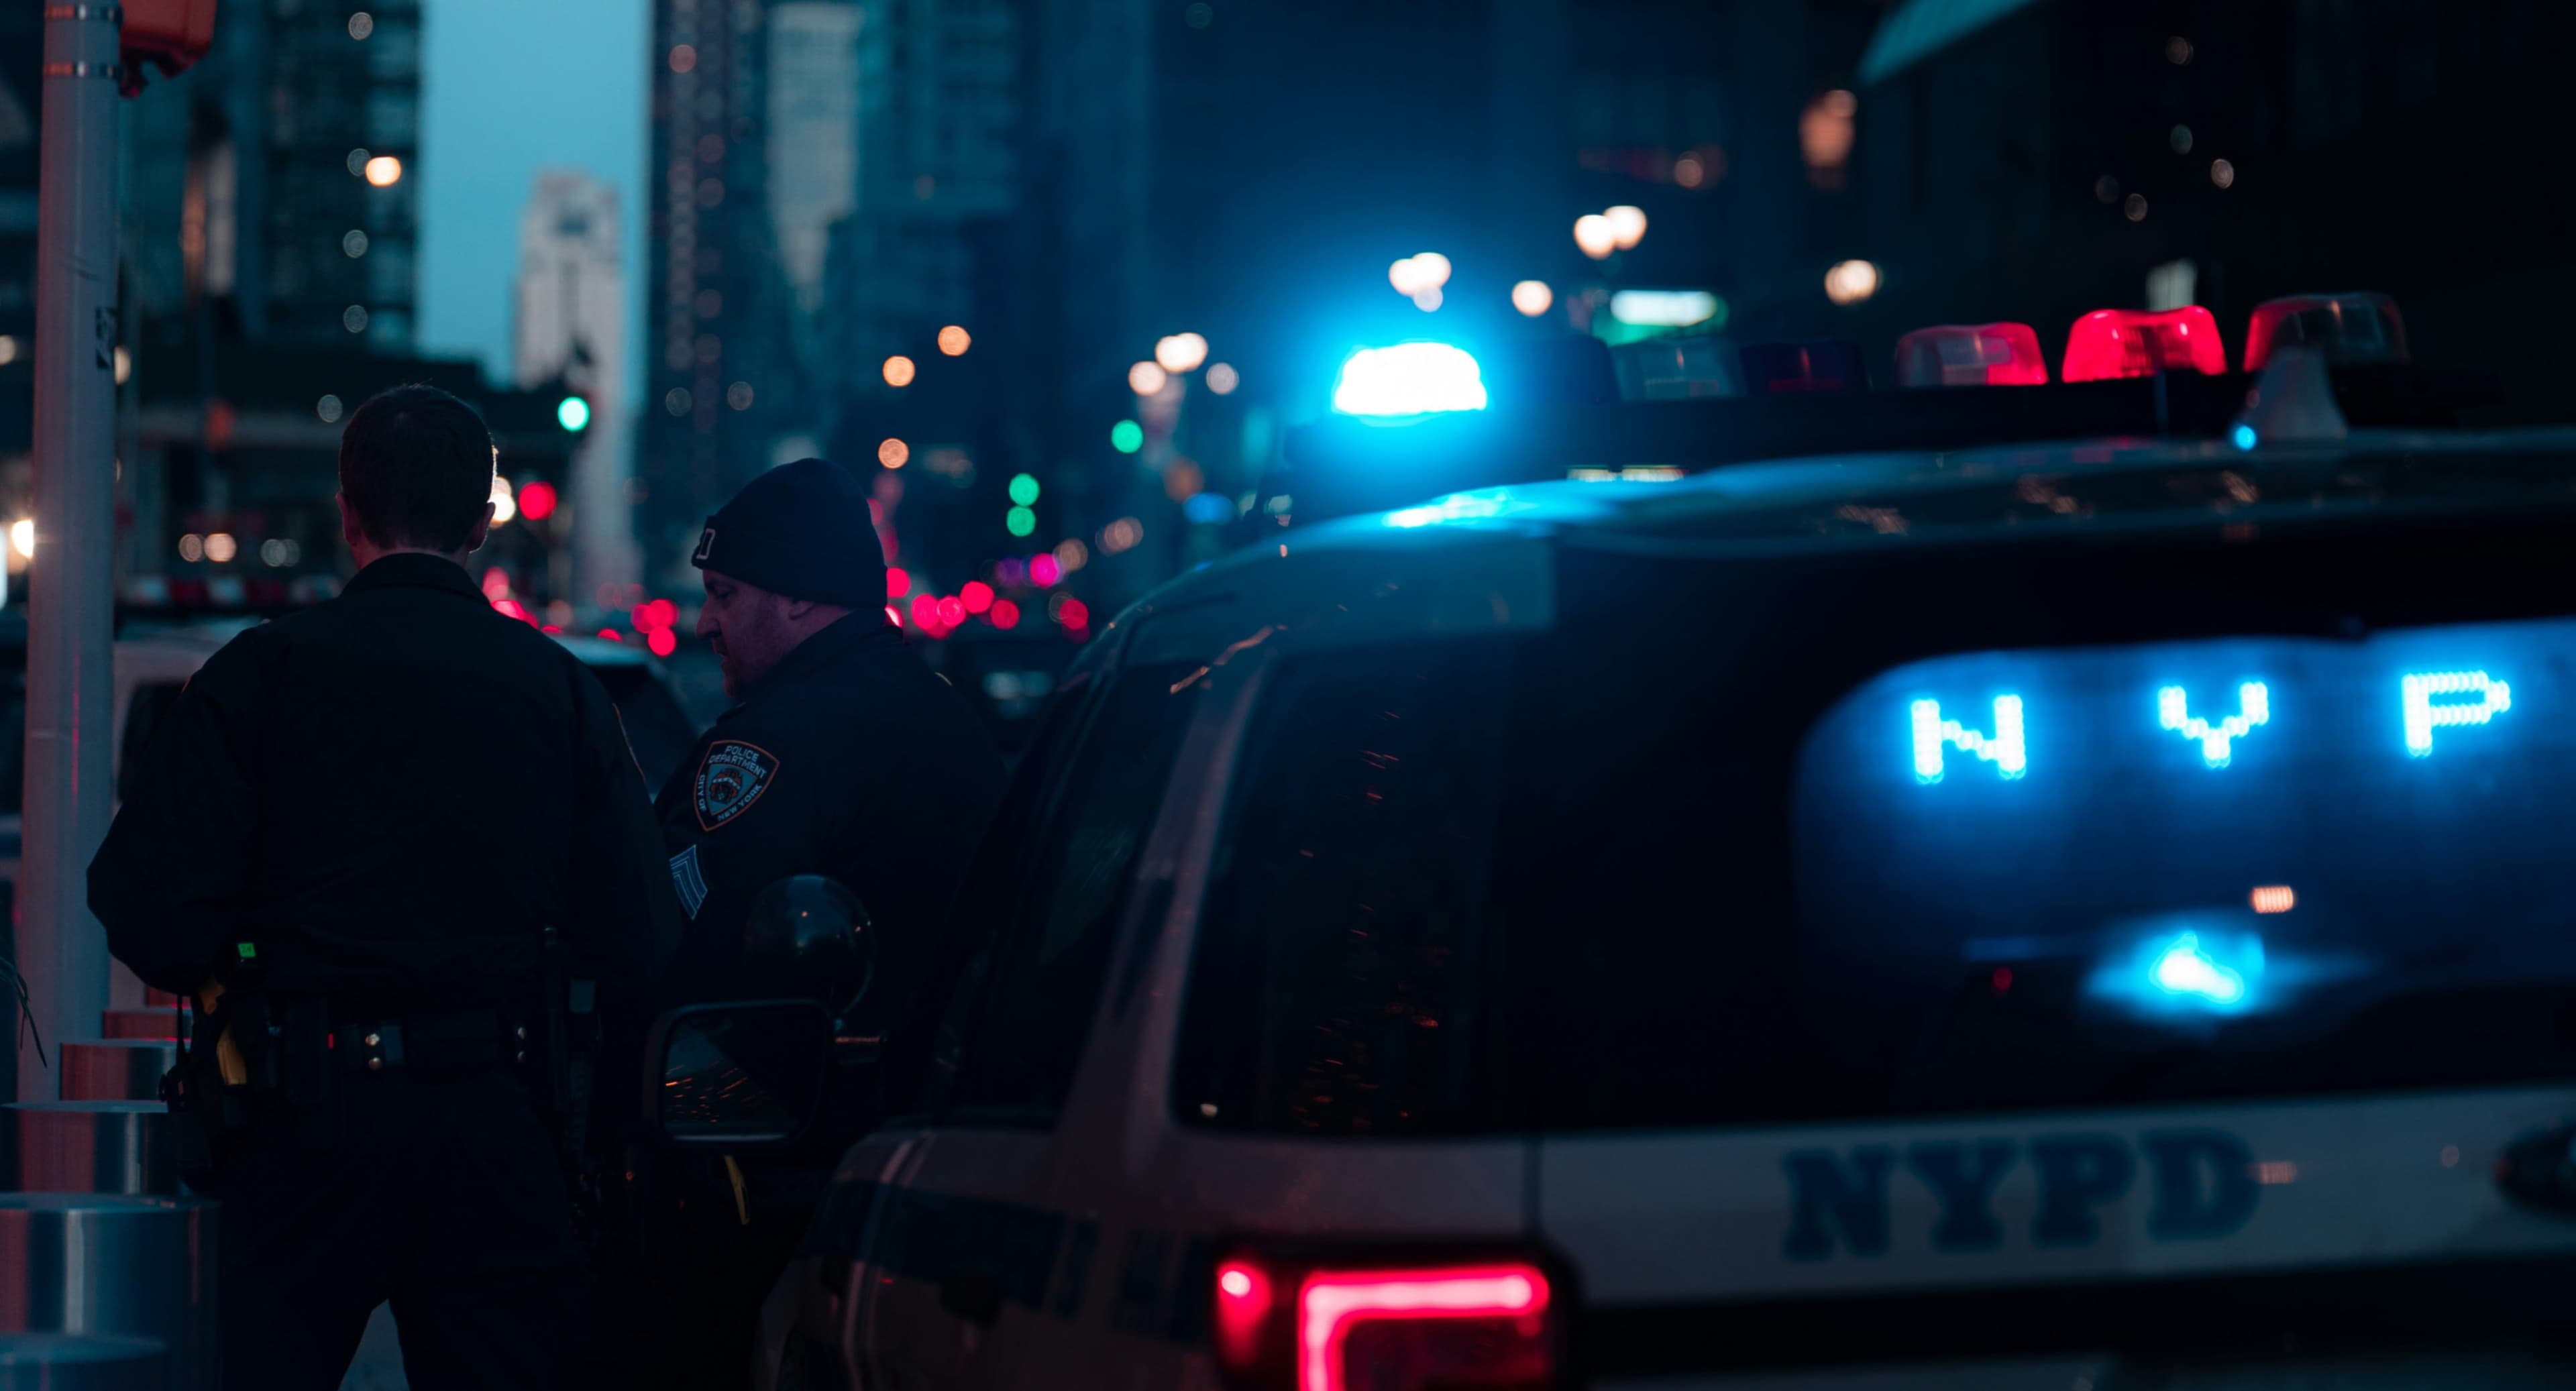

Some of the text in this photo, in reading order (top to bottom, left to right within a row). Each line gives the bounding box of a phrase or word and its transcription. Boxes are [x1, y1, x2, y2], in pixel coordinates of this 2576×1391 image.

[708, 754, 767, 779] DEPARTMENT
[724, 745, 760, 763] POLICE
[697, 774, 707, 812] CITY OF
[717, 783, 763, 822] NEW YORK
[1781, 1128, 2261, 1262] NYPD
